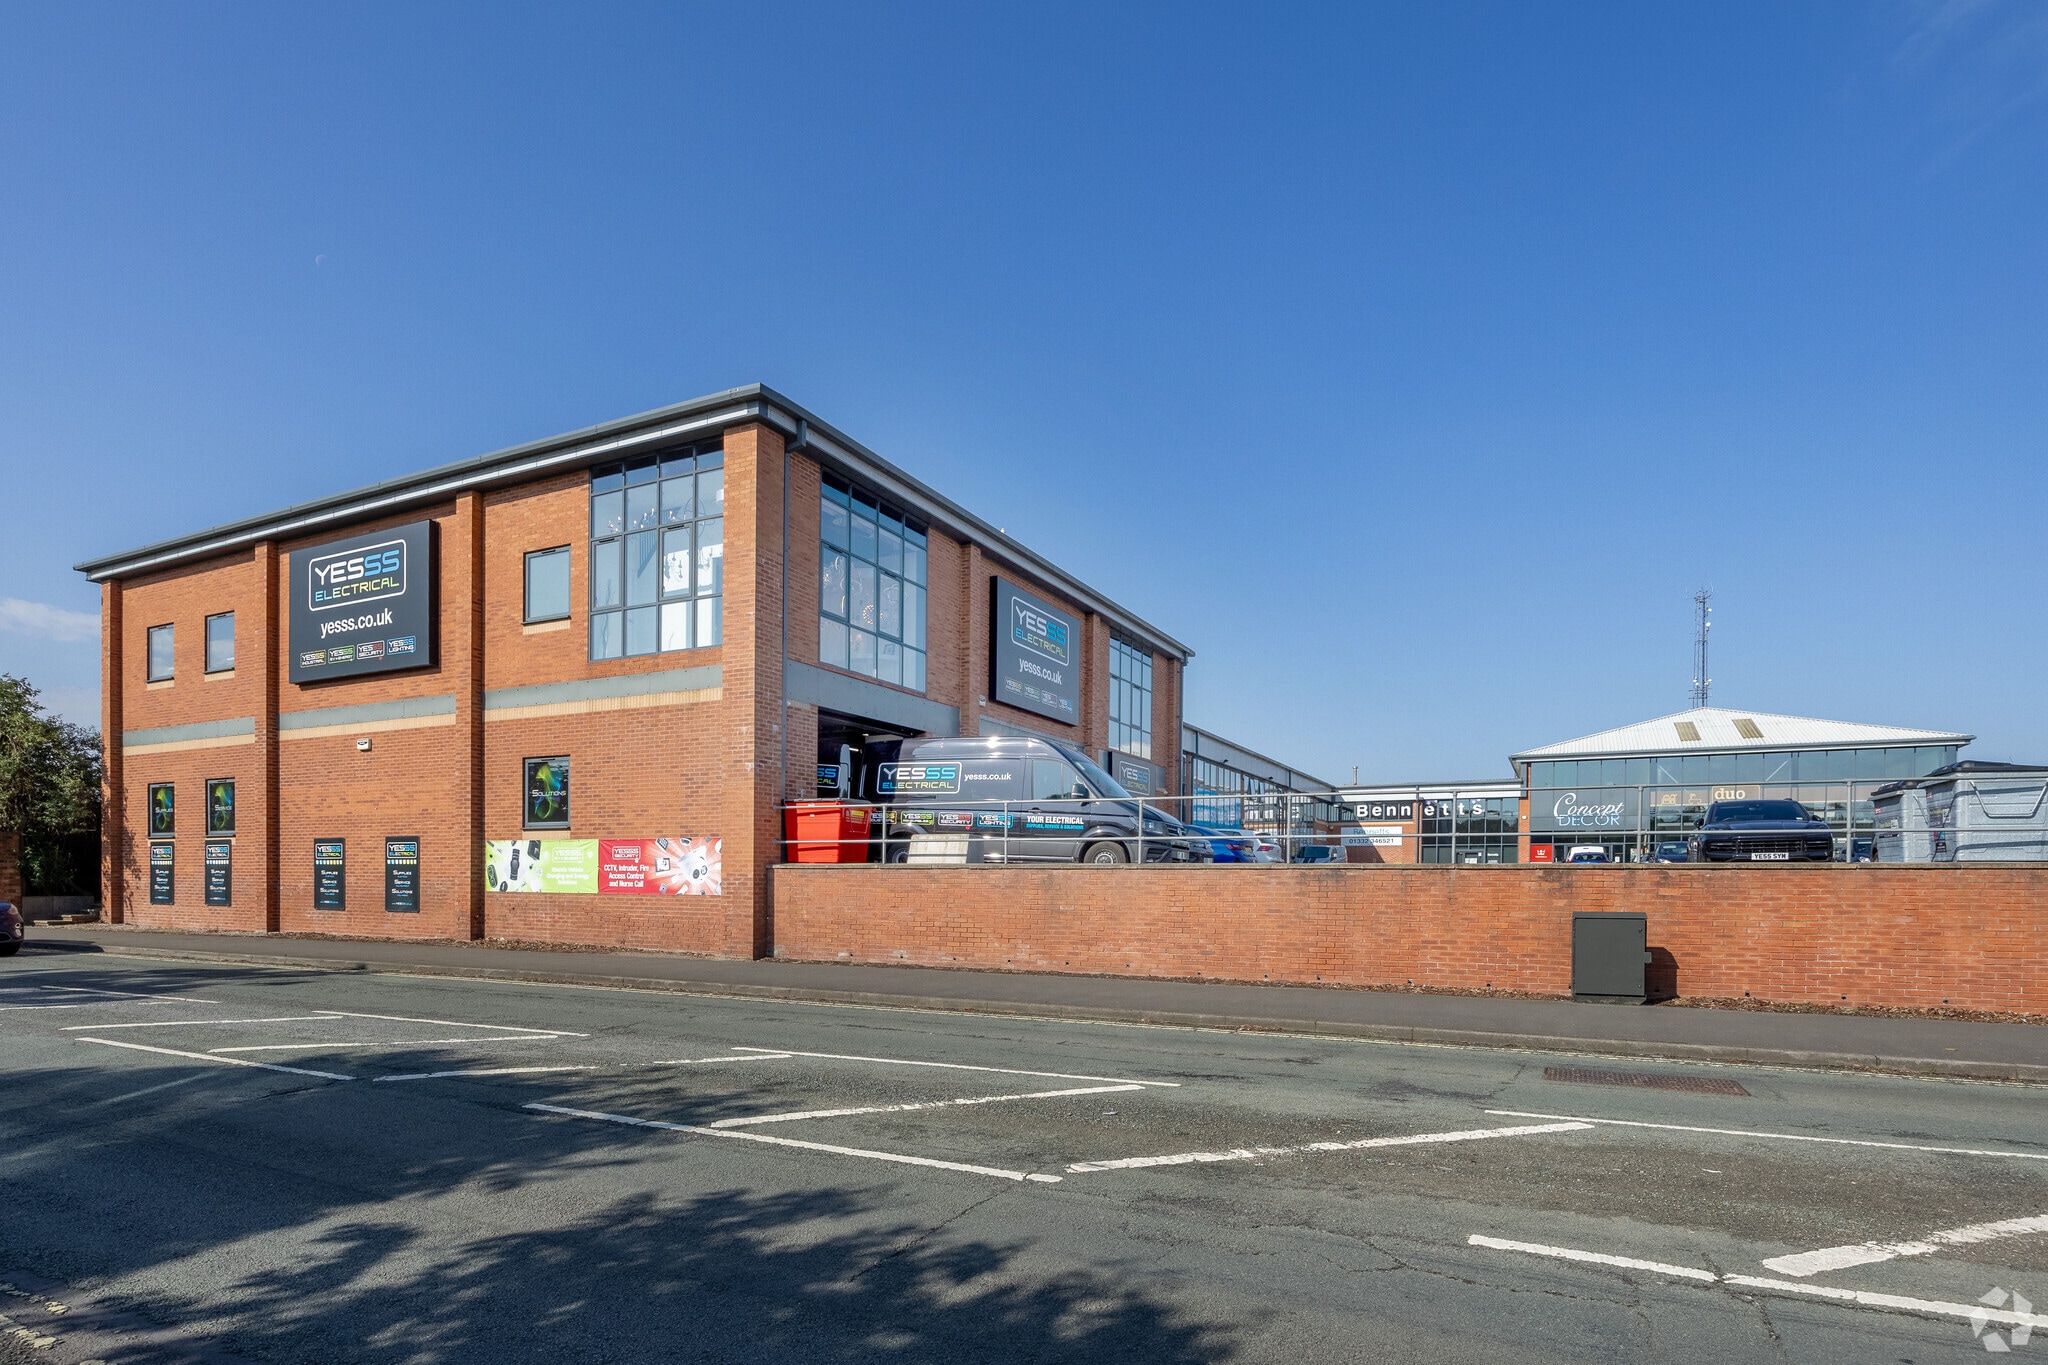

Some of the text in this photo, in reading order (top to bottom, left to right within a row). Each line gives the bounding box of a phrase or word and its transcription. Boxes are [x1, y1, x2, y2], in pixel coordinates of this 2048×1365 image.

[314, 549, 400, 586] YESSS
[315, 576, 400, 602] ELECTRICAL
[320, 607, 393, 639] yesss.co.uk
[1016, 605, 1067, 645] YESSS
[358, 643, 383, 652] YESSS
[389, 638, 414, 648] YESSS
[389, 645, 415, 653] LIGHTING
[1015, 628, 1066, 658] ELECTRICAL
[302, 652, 325, 661] YESSS
[329, 648, 353, 657] YESSS
[1019, 657, 1062, 686] yesss.co.uk
[883, 767, 956, 780] YESSS
[964, 772, 1012, 781] yesss.co.uk
[1122, 767, 1149, 782] YESSS
[882, 781, 954, 789] ELECTRICAL
[1122, 781, 1148, 791] ELECTRICAL
[1714, 788, 1746, 800] duo
[1356, 802, 1483, 817] Bennetts
[1553, 792, 1625, 819] Concept
[1026, 815, 1084, 824] YOUR ELECTRICAL
[1558, 813, 1620, 826] DECOR
[604, 864, 618, 872] CCTV,
[634, 880, 644, 888] Call
